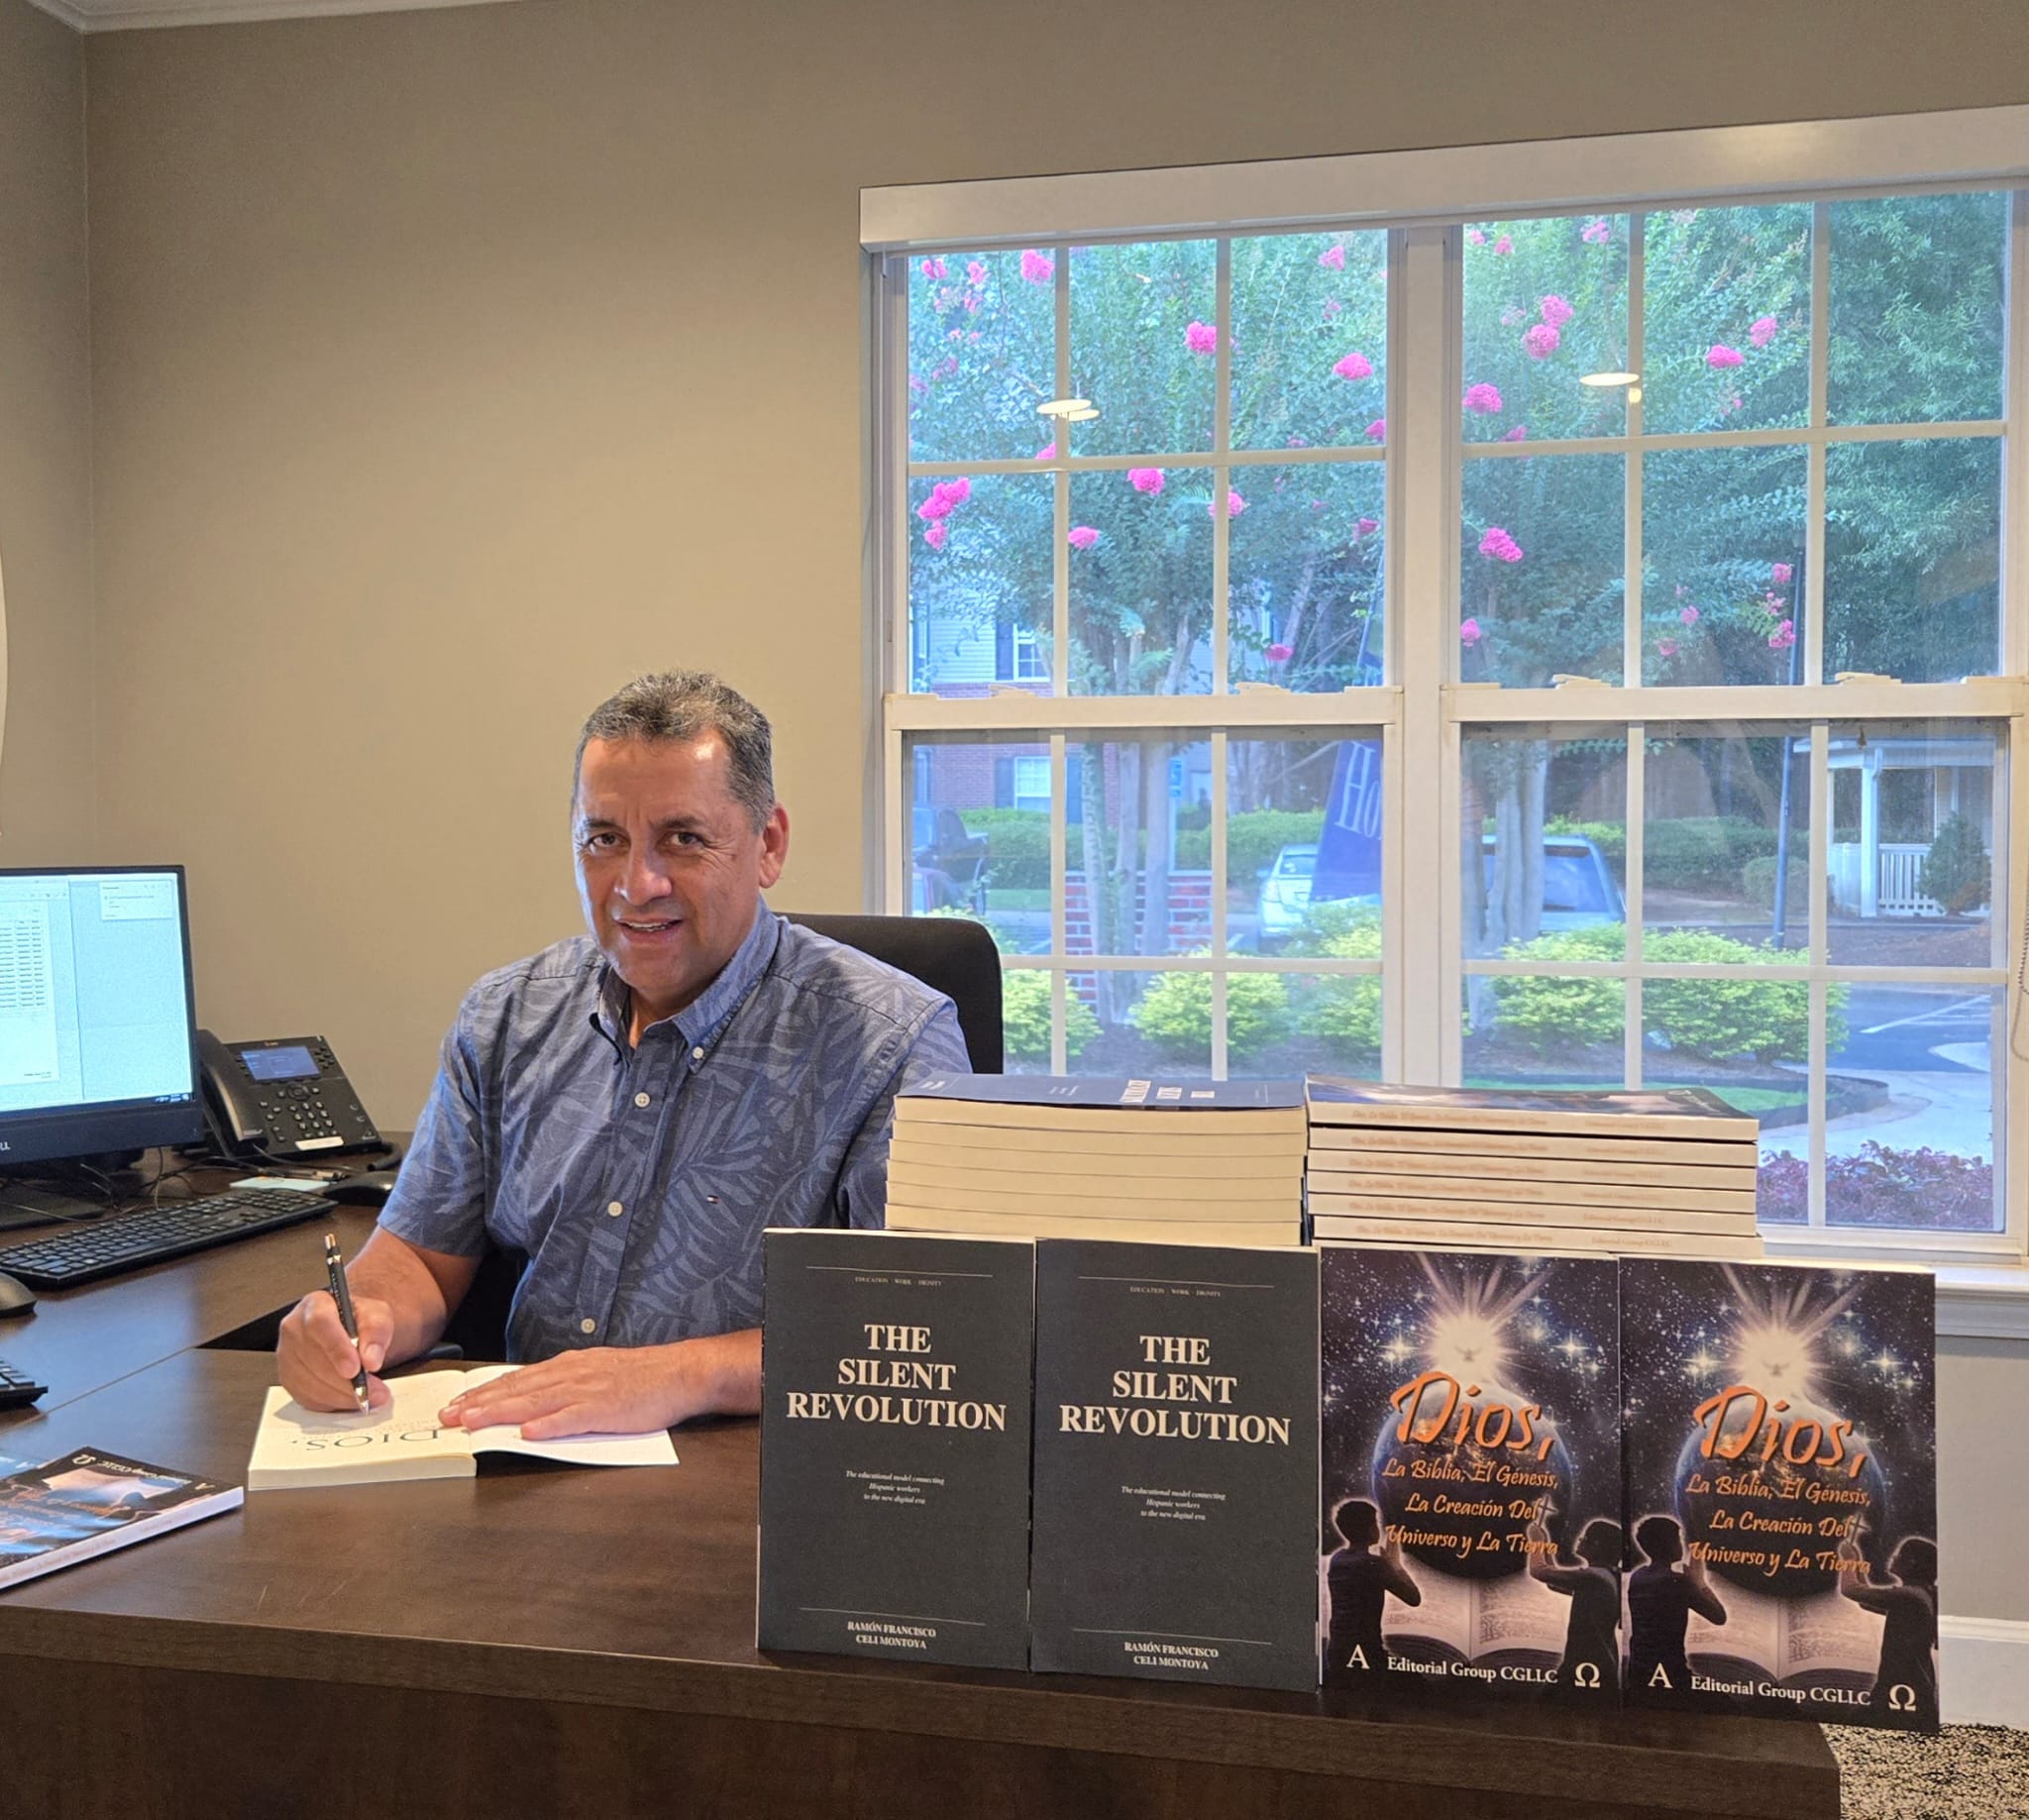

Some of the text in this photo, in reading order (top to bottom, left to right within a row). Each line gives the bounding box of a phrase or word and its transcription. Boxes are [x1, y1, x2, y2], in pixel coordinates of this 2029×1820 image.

[864, 1324, 932, 1353] THE
[1139, 1335, 1212, 1365] THE
[838, 1357, 957, 1391] SILENT
[1113, 1370, 1237, 1404] SILENT
[786, 1392, 1008, 1432] REVOLUTION
[1059, 1405, 1292, 1445] REVOLUTION
[1390, 1370, 1555, 1461] Dios,
[1692, 1385, 1868, 1478] Dios,
[1382, 1457, 1406, 1477] La
[1411, 1458, 1466, 1483] Biblia,
[1472, 1460, 1496, 1482] El
[1121, 1485, 1133, 1494] The
[1685, 1473, 1710, 1493] La
[1715, 1475, 1773, 1500] Biblia,
[1779, 1477, 1804, 1500] El
[1405, 1492, 1543, 1520] La Creación Del
[1709, 1509, 1856, 1537] La Creación Del
[1385, 1524, 1558, 1559] Universo y La Tierra
[1688, 1541, 1871, 1577] Universo y La Tierra
[847, 1621, 937, 1638] RAMÓN FRANCISCO
[855, 1634, 927, 1650] CELI MONTOYA
[1124, 1641, 1219, 1658] RAMÓN FRANCISCO
[1133, 1655, 1209, 1670] CELI MONTOYA
[1346, 1644, 1370, 1669] A
[1387, 1656, 1558, 1683] Editorial Group CGLLC
[1574, 1662, 1601, 1688] Ω
[1648, 1662, 1673, 1689] A
[1691, 1675, 1871, 1706] Editorial Group CGLLC
[1889, 1683, 1917, 1712] Ω
